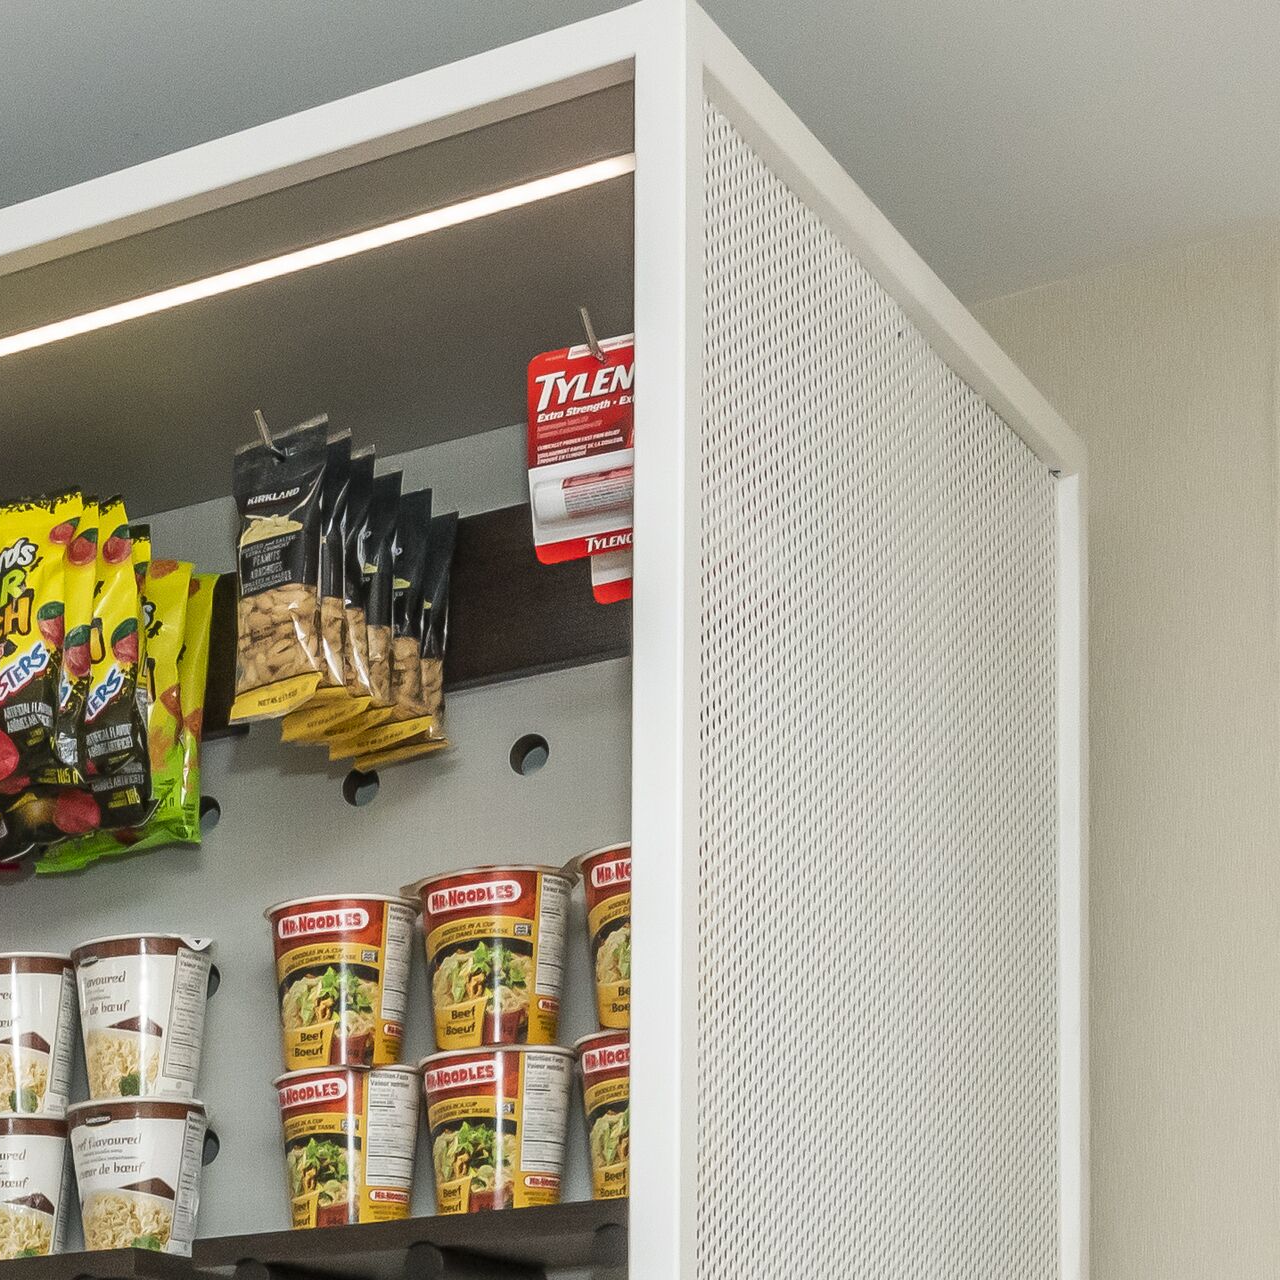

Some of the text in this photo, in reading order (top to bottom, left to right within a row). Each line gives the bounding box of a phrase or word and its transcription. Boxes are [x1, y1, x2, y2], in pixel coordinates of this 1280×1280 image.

[537, 399, 611, 423] Extra Strength
[247, 486, 301, 506] KIRKLAND
[448, 884, 515, 907] NOODLES
[451, 1005, 476, 1020] Beef
[300, 1029, 324, 1043] Beef
[446, 1022, 476, 1036] Boeuf
[294, 1045, 324, 1059] Boeuf
[437, 1065, 496, 1087] NOODLES
[285, 1082, 340, 1104] NOODLES
[604, 1167, 627, 1183] Beef
